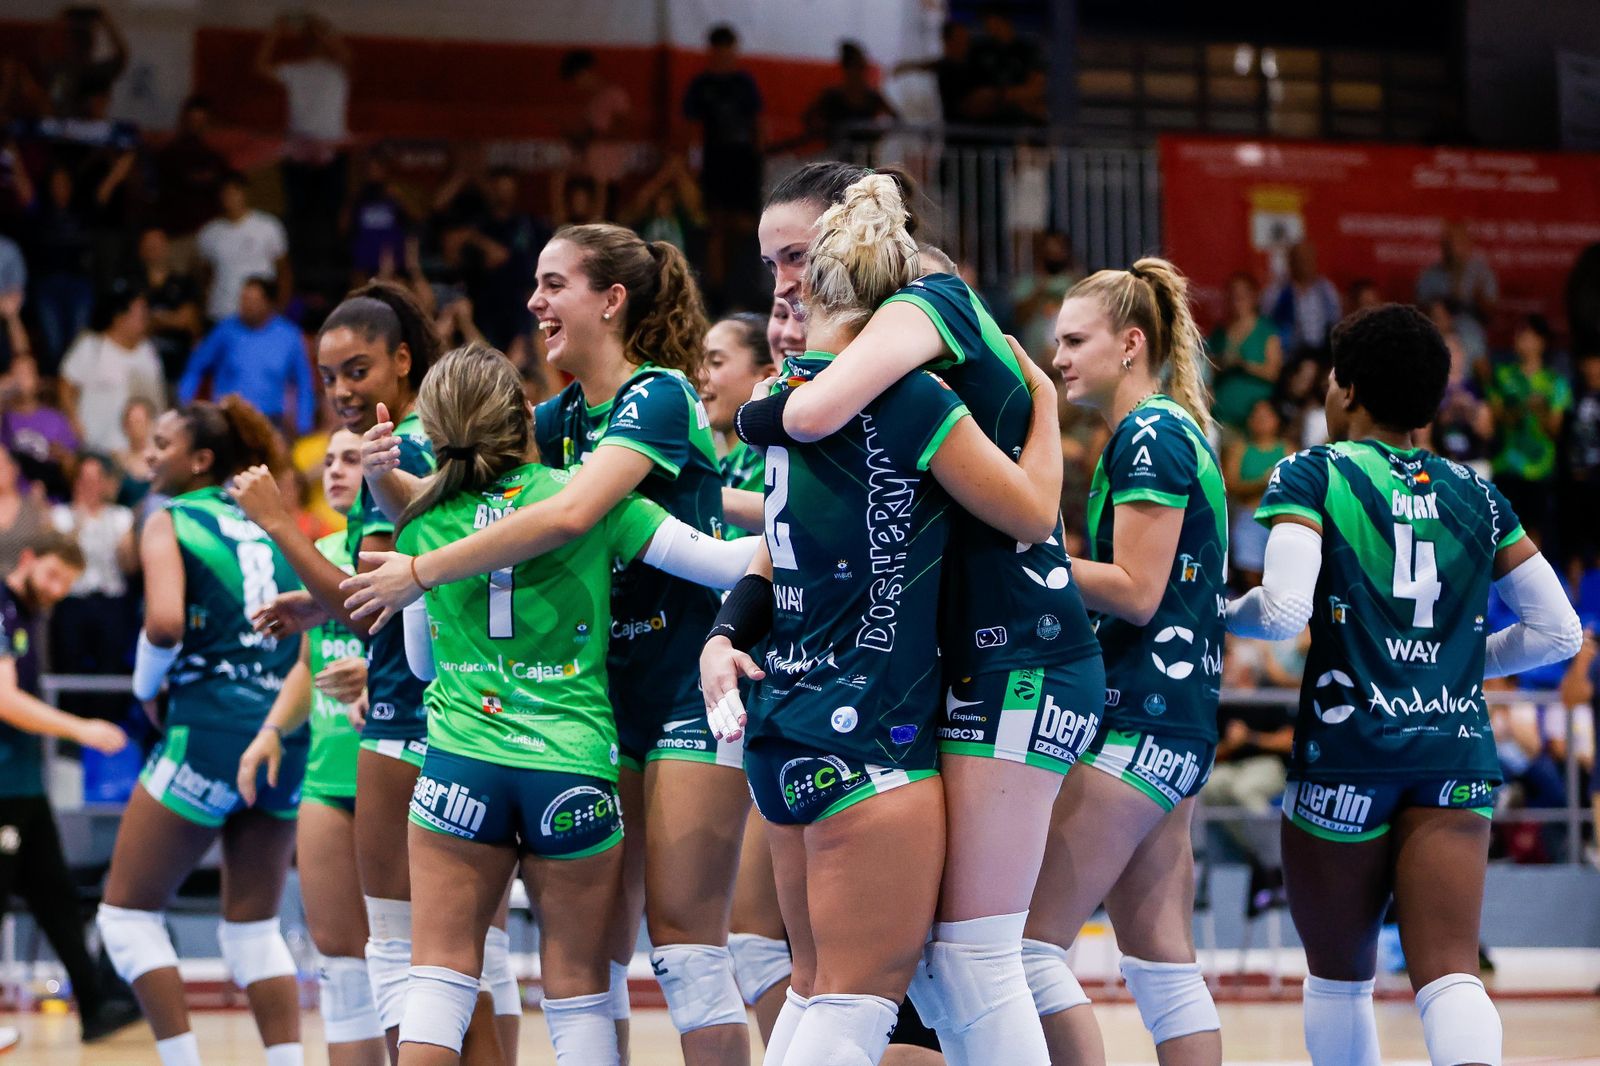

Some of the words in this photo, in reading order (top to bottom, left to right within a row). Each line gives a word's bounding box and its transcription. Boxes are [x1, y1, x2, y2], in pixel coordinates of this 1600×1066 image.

[765, 446, 799, 571] 2
[1393, 522, 1442, 629] 4
[773, 584, 804, 613] WAY
[611, 610, 667, 640] Cajasol
[1385, 638, 1441, 664] WAY
[511, 658, 581, 683] Cajasol
[1368, 681, 1486, 718] Andalucí
[952, 712, 987, 722] Esquimo
[656, 738, 694, 749] emec
[1137, 735, 1200, 796] berlin
